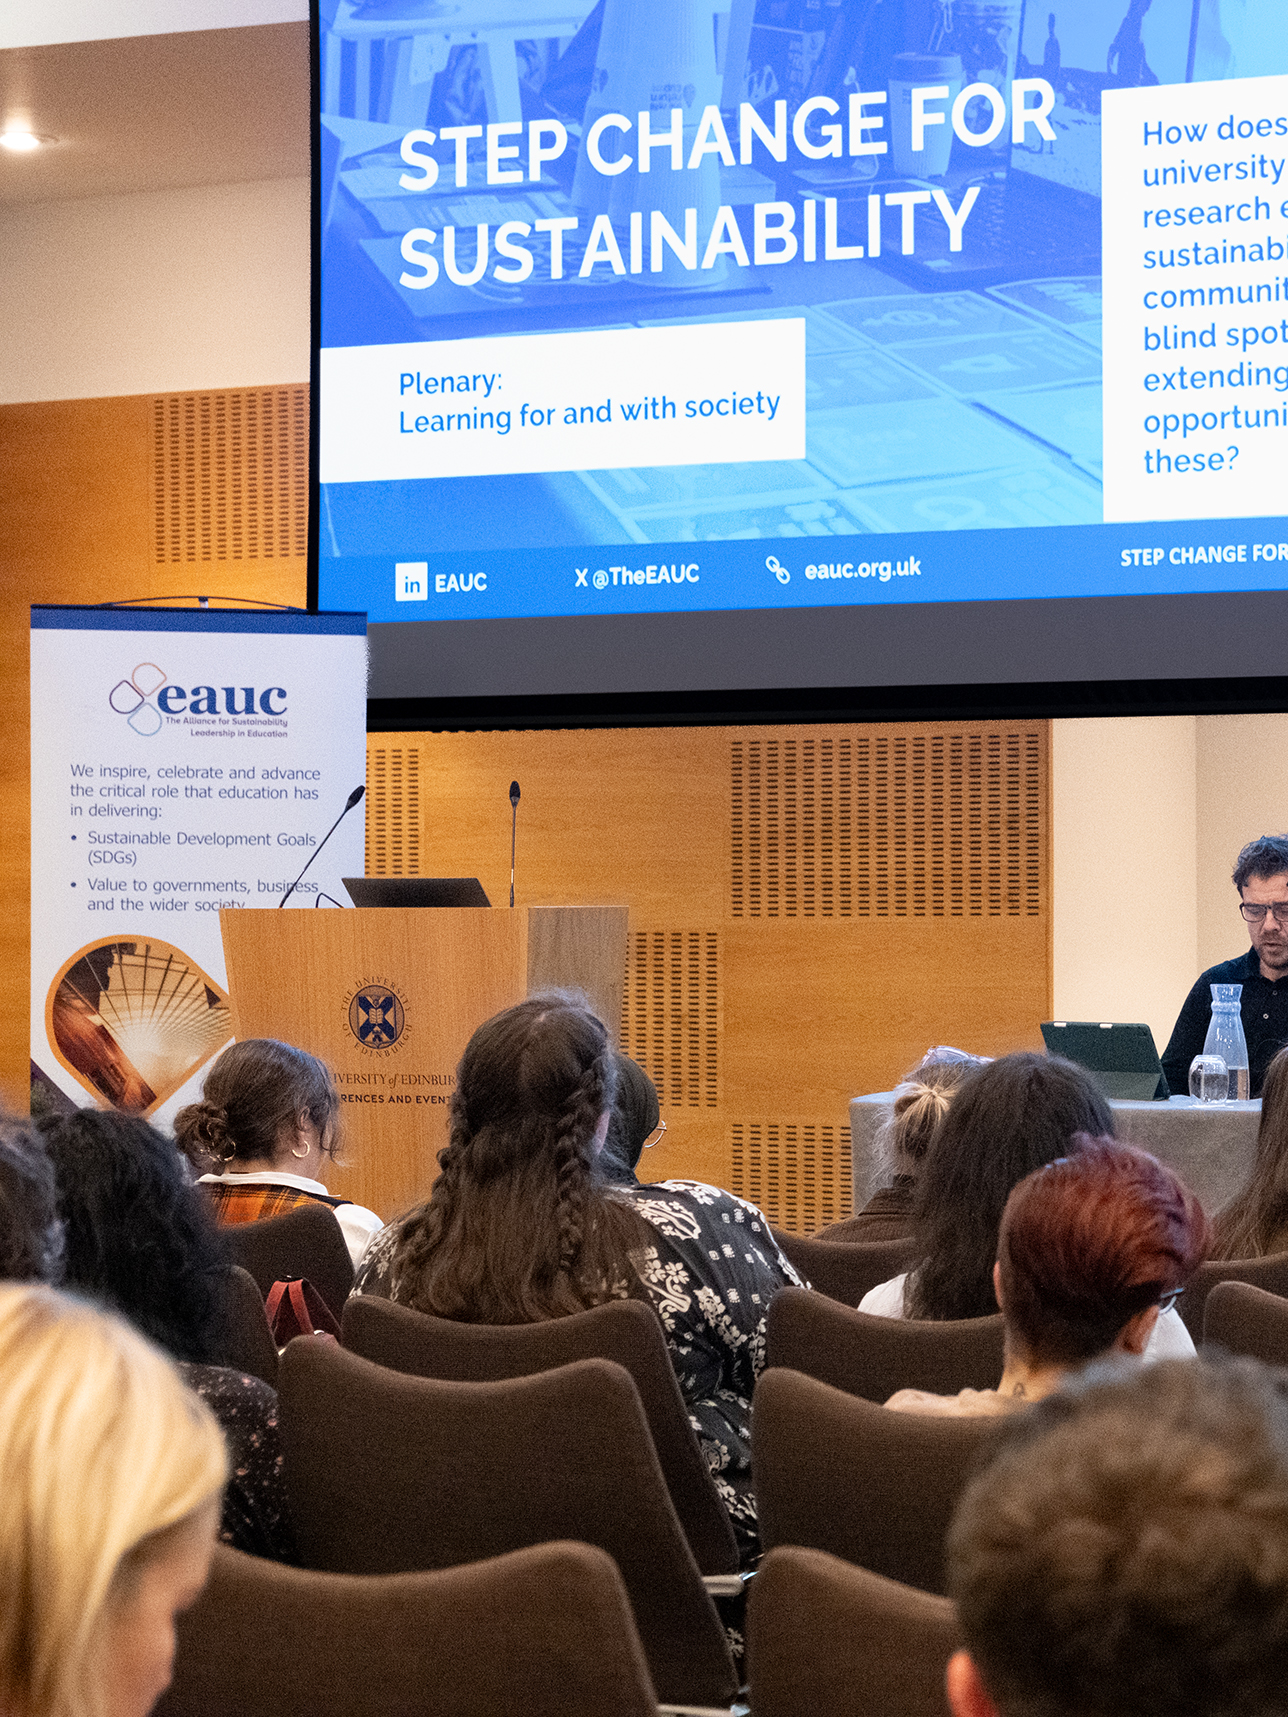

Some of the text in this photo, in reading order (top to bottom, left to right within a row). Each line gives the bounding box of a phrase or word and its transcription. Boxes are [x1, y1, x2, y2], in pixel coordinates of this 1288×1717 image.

[399, 79, 1056, 191] STEP CHANGE FOR
[1144, 121, 1207, 146] How
[1217, 115, 1287, 140] does
[1144, 154, 1285, 187] university
[1144, 196, 1270, 228] research
[400, 187, 980, 289] SUSTAINABILITY
[1145, 323, 1216, 351] blind
[400, 372, 501, 398] Plenary:
[400, 391, 780, 435] Learning for and with society
[1144, 446, 1239, 474] these?
[1122, 549, 1164, 566] STEP
[1170, 546, 1246, 564] CHANGE
[1254, 544, 1288, 561] FOR
[576, 565, 699, 587] X @TheEAUC
[806, 557, 920, 581] eauc.org.uk
[405, 576, 420, 593] in
[436, 573, 486, 592] EAUC
[157, 685, 288, 715] eauc
[165, 716, 288, 727] The Alliance for Sustainability
[190, 729, 236, 738] Leadership
[247, 730, 288, 738] Education
[70, 765, 320, 781] We inspire, celebrate and advance
[70, 784, 318, 800] the critical role that education has
[70, 804, 162, 820] in delivering:
[88, 831, 316, 848] Sustainable Development Goals
[88, 850, 137, 866] (SDGs)
[88, 878, 318, 894] Value to governments, business
[88, 898, 114, 911] and
[121, 898, 144, 911] the
[150, 898, 186, 911] wider
[341, 976, 412, 1013] THE UNIVERSITY
[342, 1022, 413, 1059] OF EDINBURGH
[333, 1073, 456, 1090] IVERSITY of EDINBUR
[340, 1094, 450, 1104] RENCES AND EVEN
